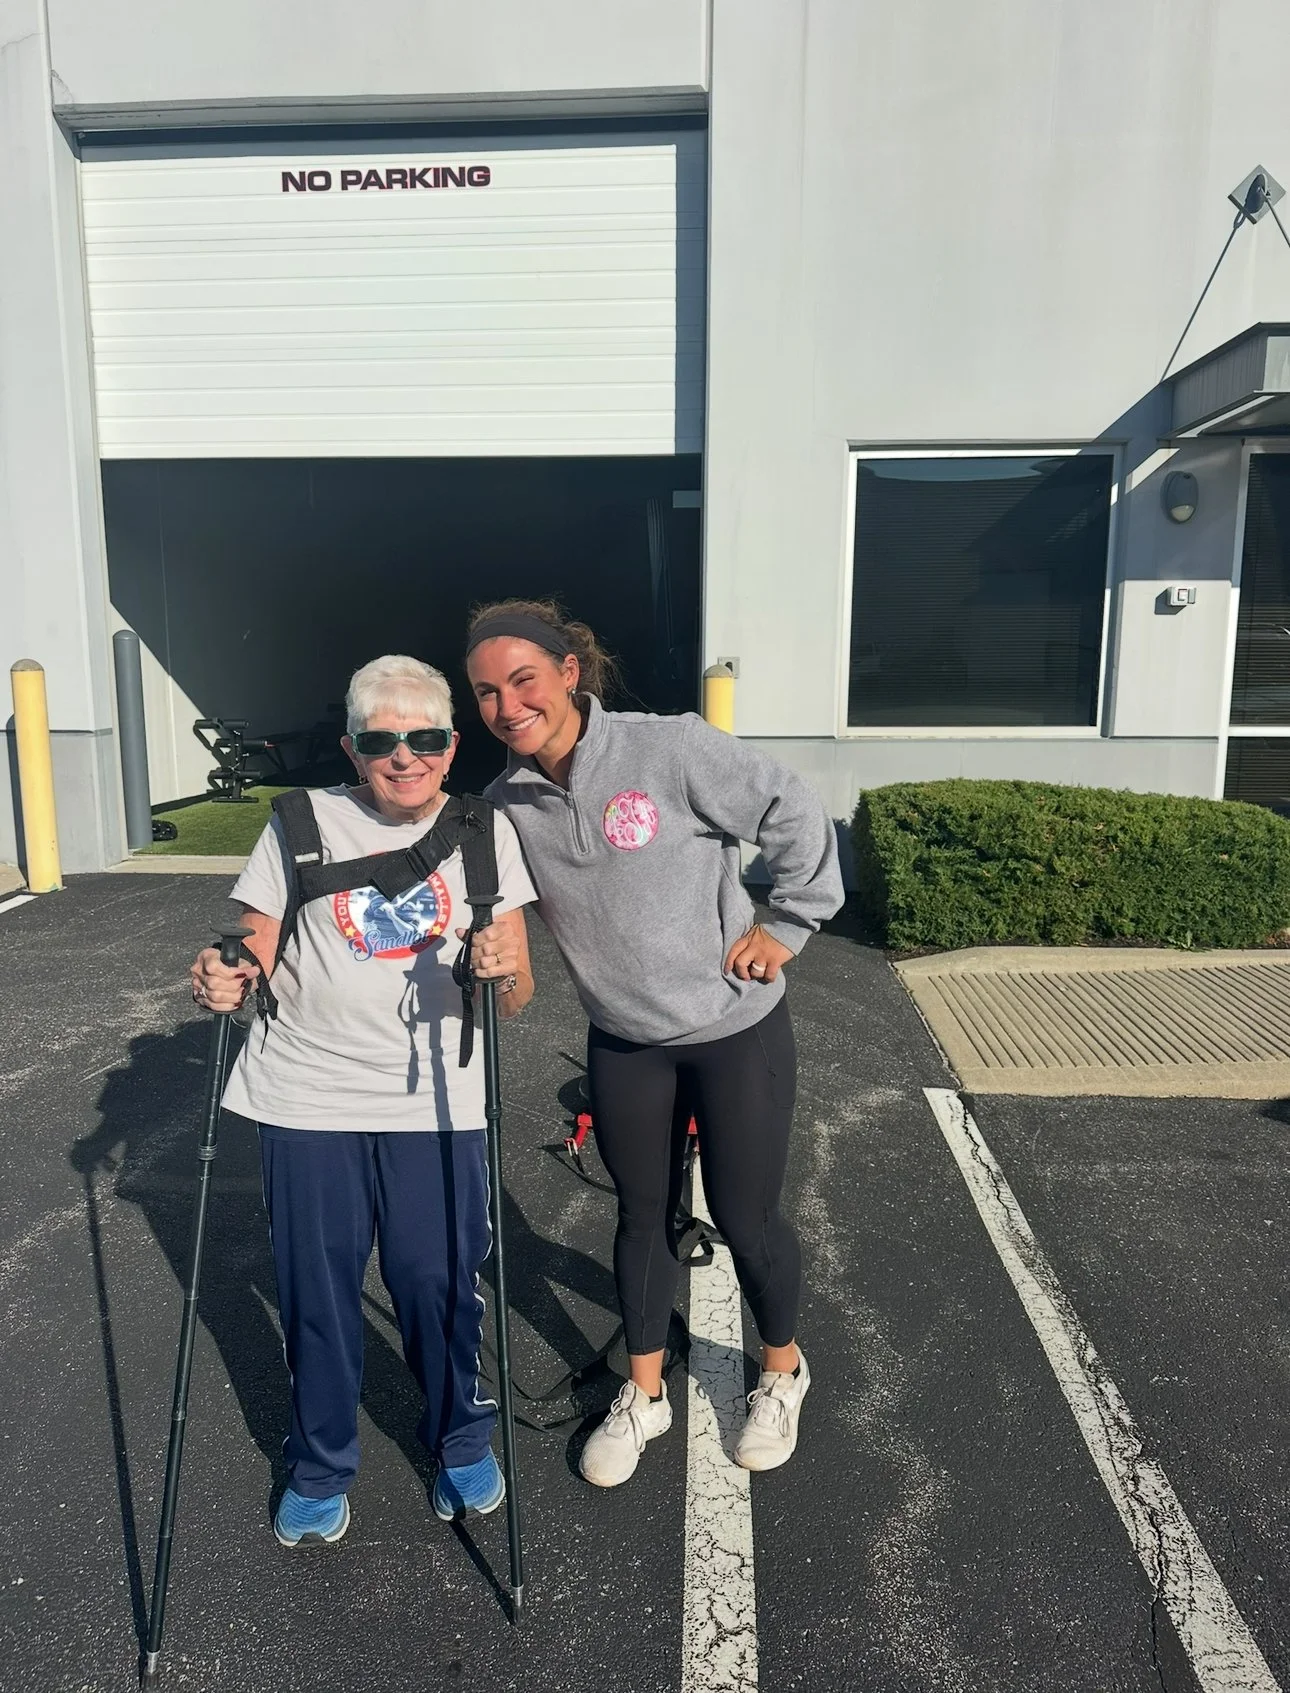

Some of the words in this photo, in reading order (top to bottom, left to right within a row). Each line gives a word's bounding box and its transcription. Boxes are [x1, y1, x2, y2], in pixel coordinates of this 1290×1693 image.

[281, 170, 332, 193] NO
[340, 165, 491, 191] PARKING
[348, 929, 430, 962] Sandlot
